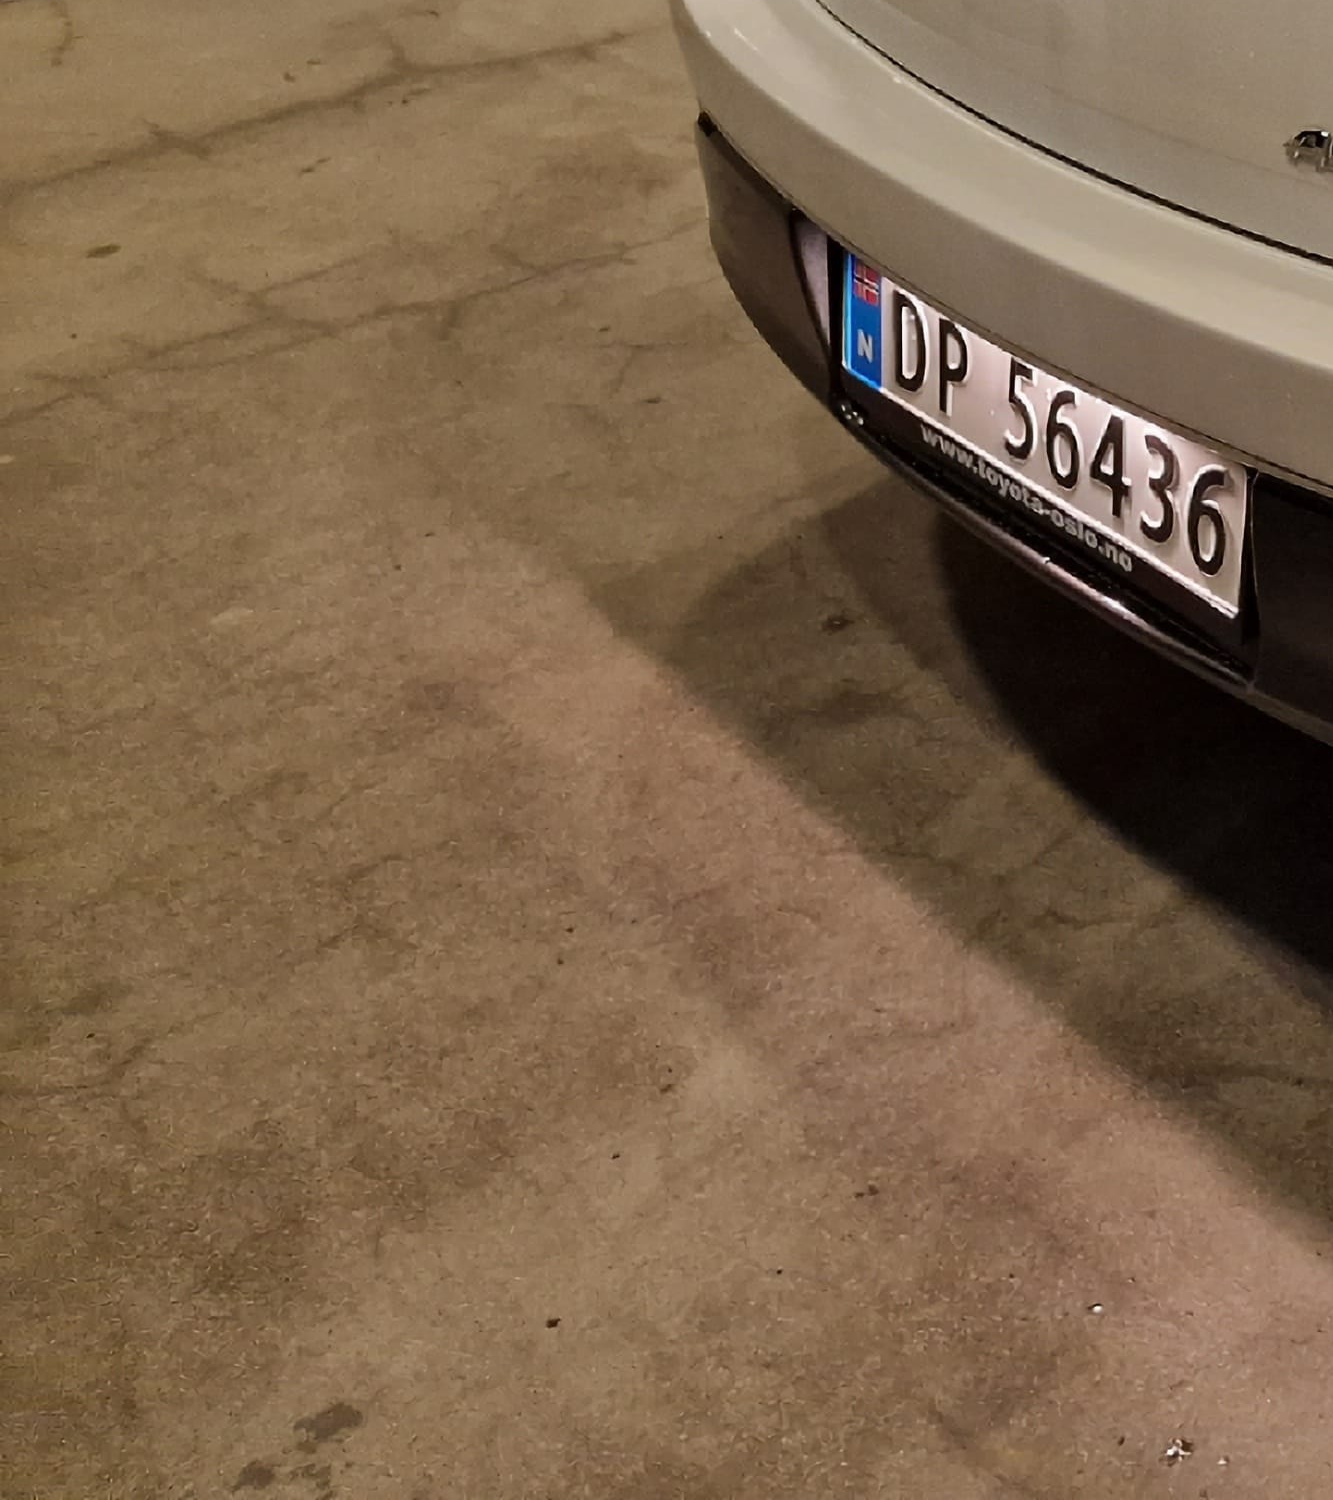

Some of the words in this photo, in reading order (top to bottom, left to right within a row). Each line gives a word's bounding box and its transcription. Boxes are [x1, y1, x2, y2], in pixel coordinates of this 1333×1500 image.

[857, 328, 873, 363] N
[893, 289, 968, 413] DP
[1004, 357, 1226, 576] 56436
[920, 424, 1133, 572] www.toyota-oslo.no
